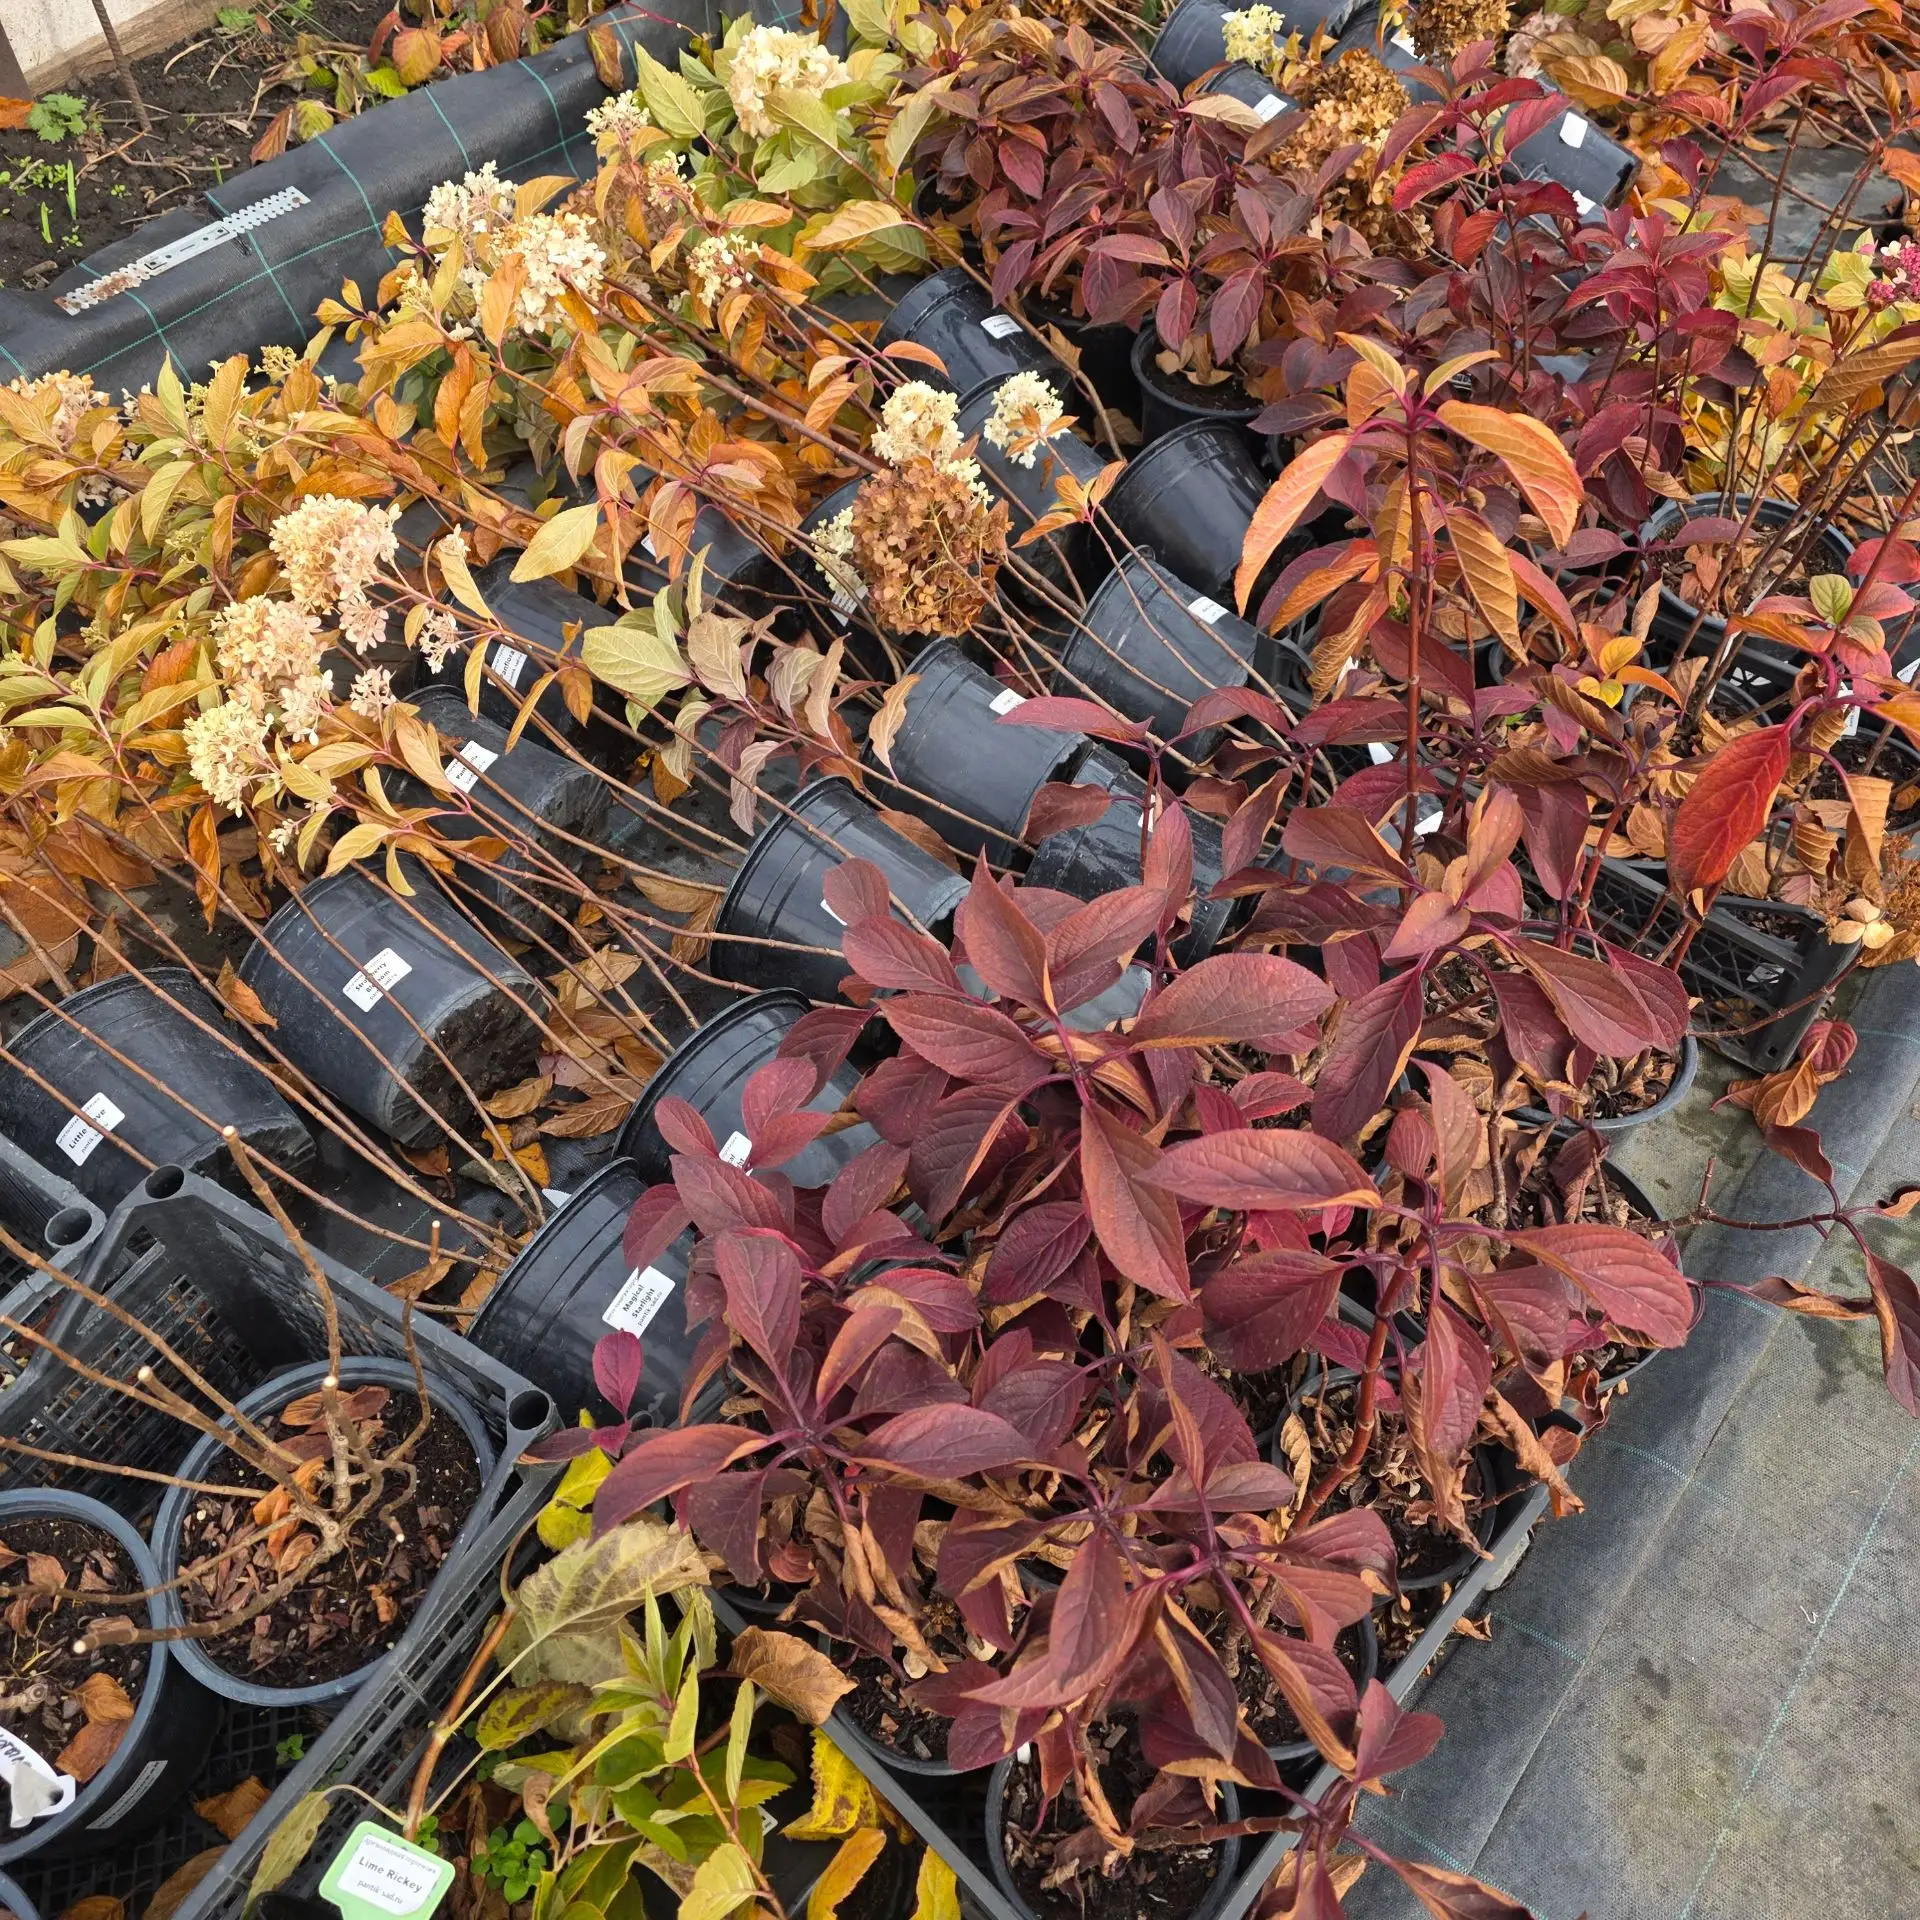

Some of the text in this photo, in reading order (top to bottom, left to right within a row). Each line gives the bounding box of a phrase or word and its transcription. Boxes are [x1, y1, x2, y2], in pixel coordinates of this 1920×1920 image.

[68, 1128, 88, 1149] Little
[622, 1284, 645, 1312] Magical
[631, 1288, 656, 1319] Starlight
[358, 1856, 385, 1875] Lime
[386, 1869, 423, 1894] Rickey
